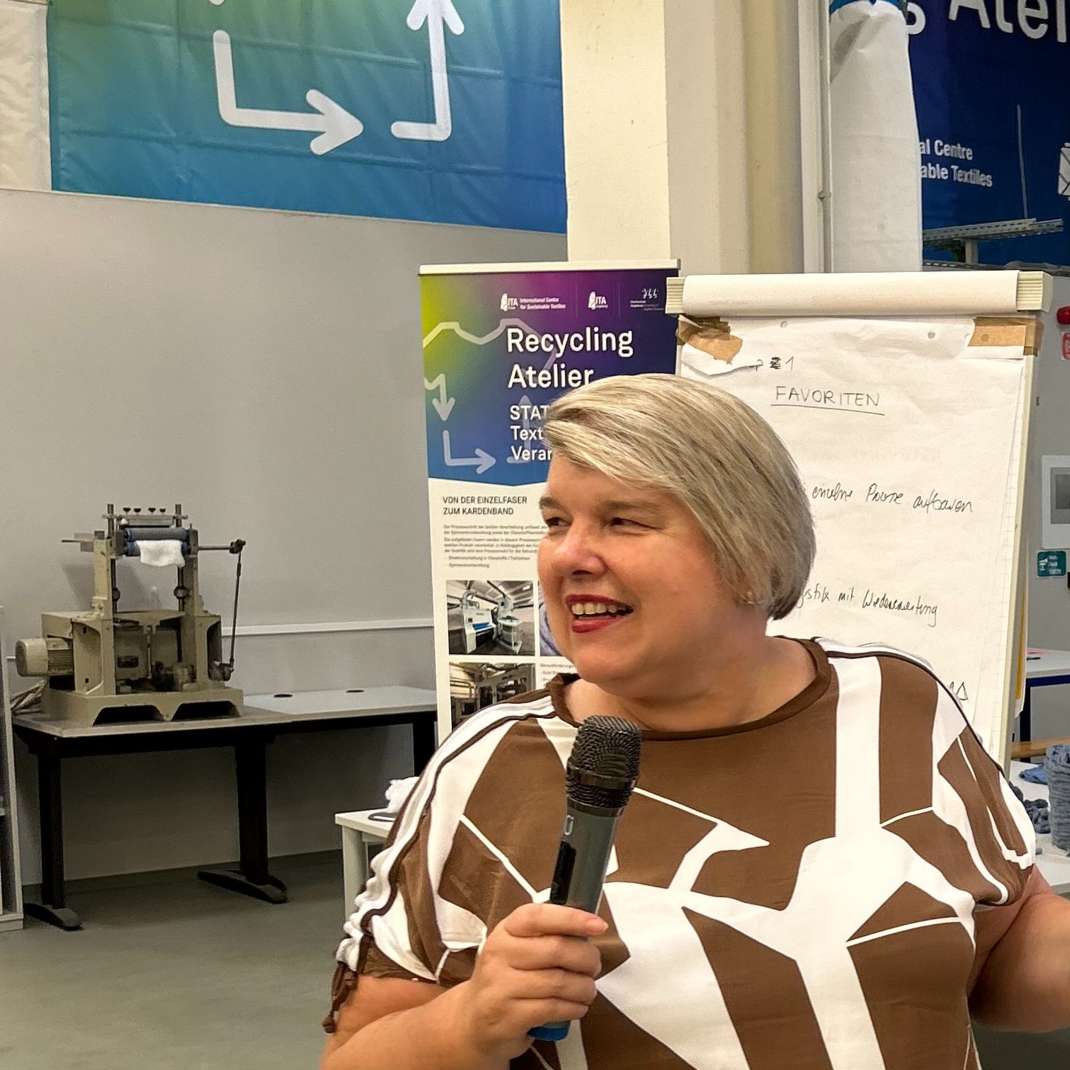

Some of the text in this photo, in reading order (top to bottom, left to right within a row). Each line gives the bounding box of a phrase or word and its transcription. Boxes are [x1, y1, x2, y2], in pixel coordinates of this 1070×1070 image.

[919, 138, 974, 161] al Centre
[920, 162, 993, 188] able Textiles
[506, 327, 634, 358] Recycling
[507, 363, 594, 389] Atelier
[775, 385, 881, 407] FAVORITEN
[510, 404, 550, 420] STAT
[510, 425, 544, 441] Text
[442, 495, 459, 504] VON
[460, 495, 476, 504] DER
[443, 507, 461, 515] ZUM
